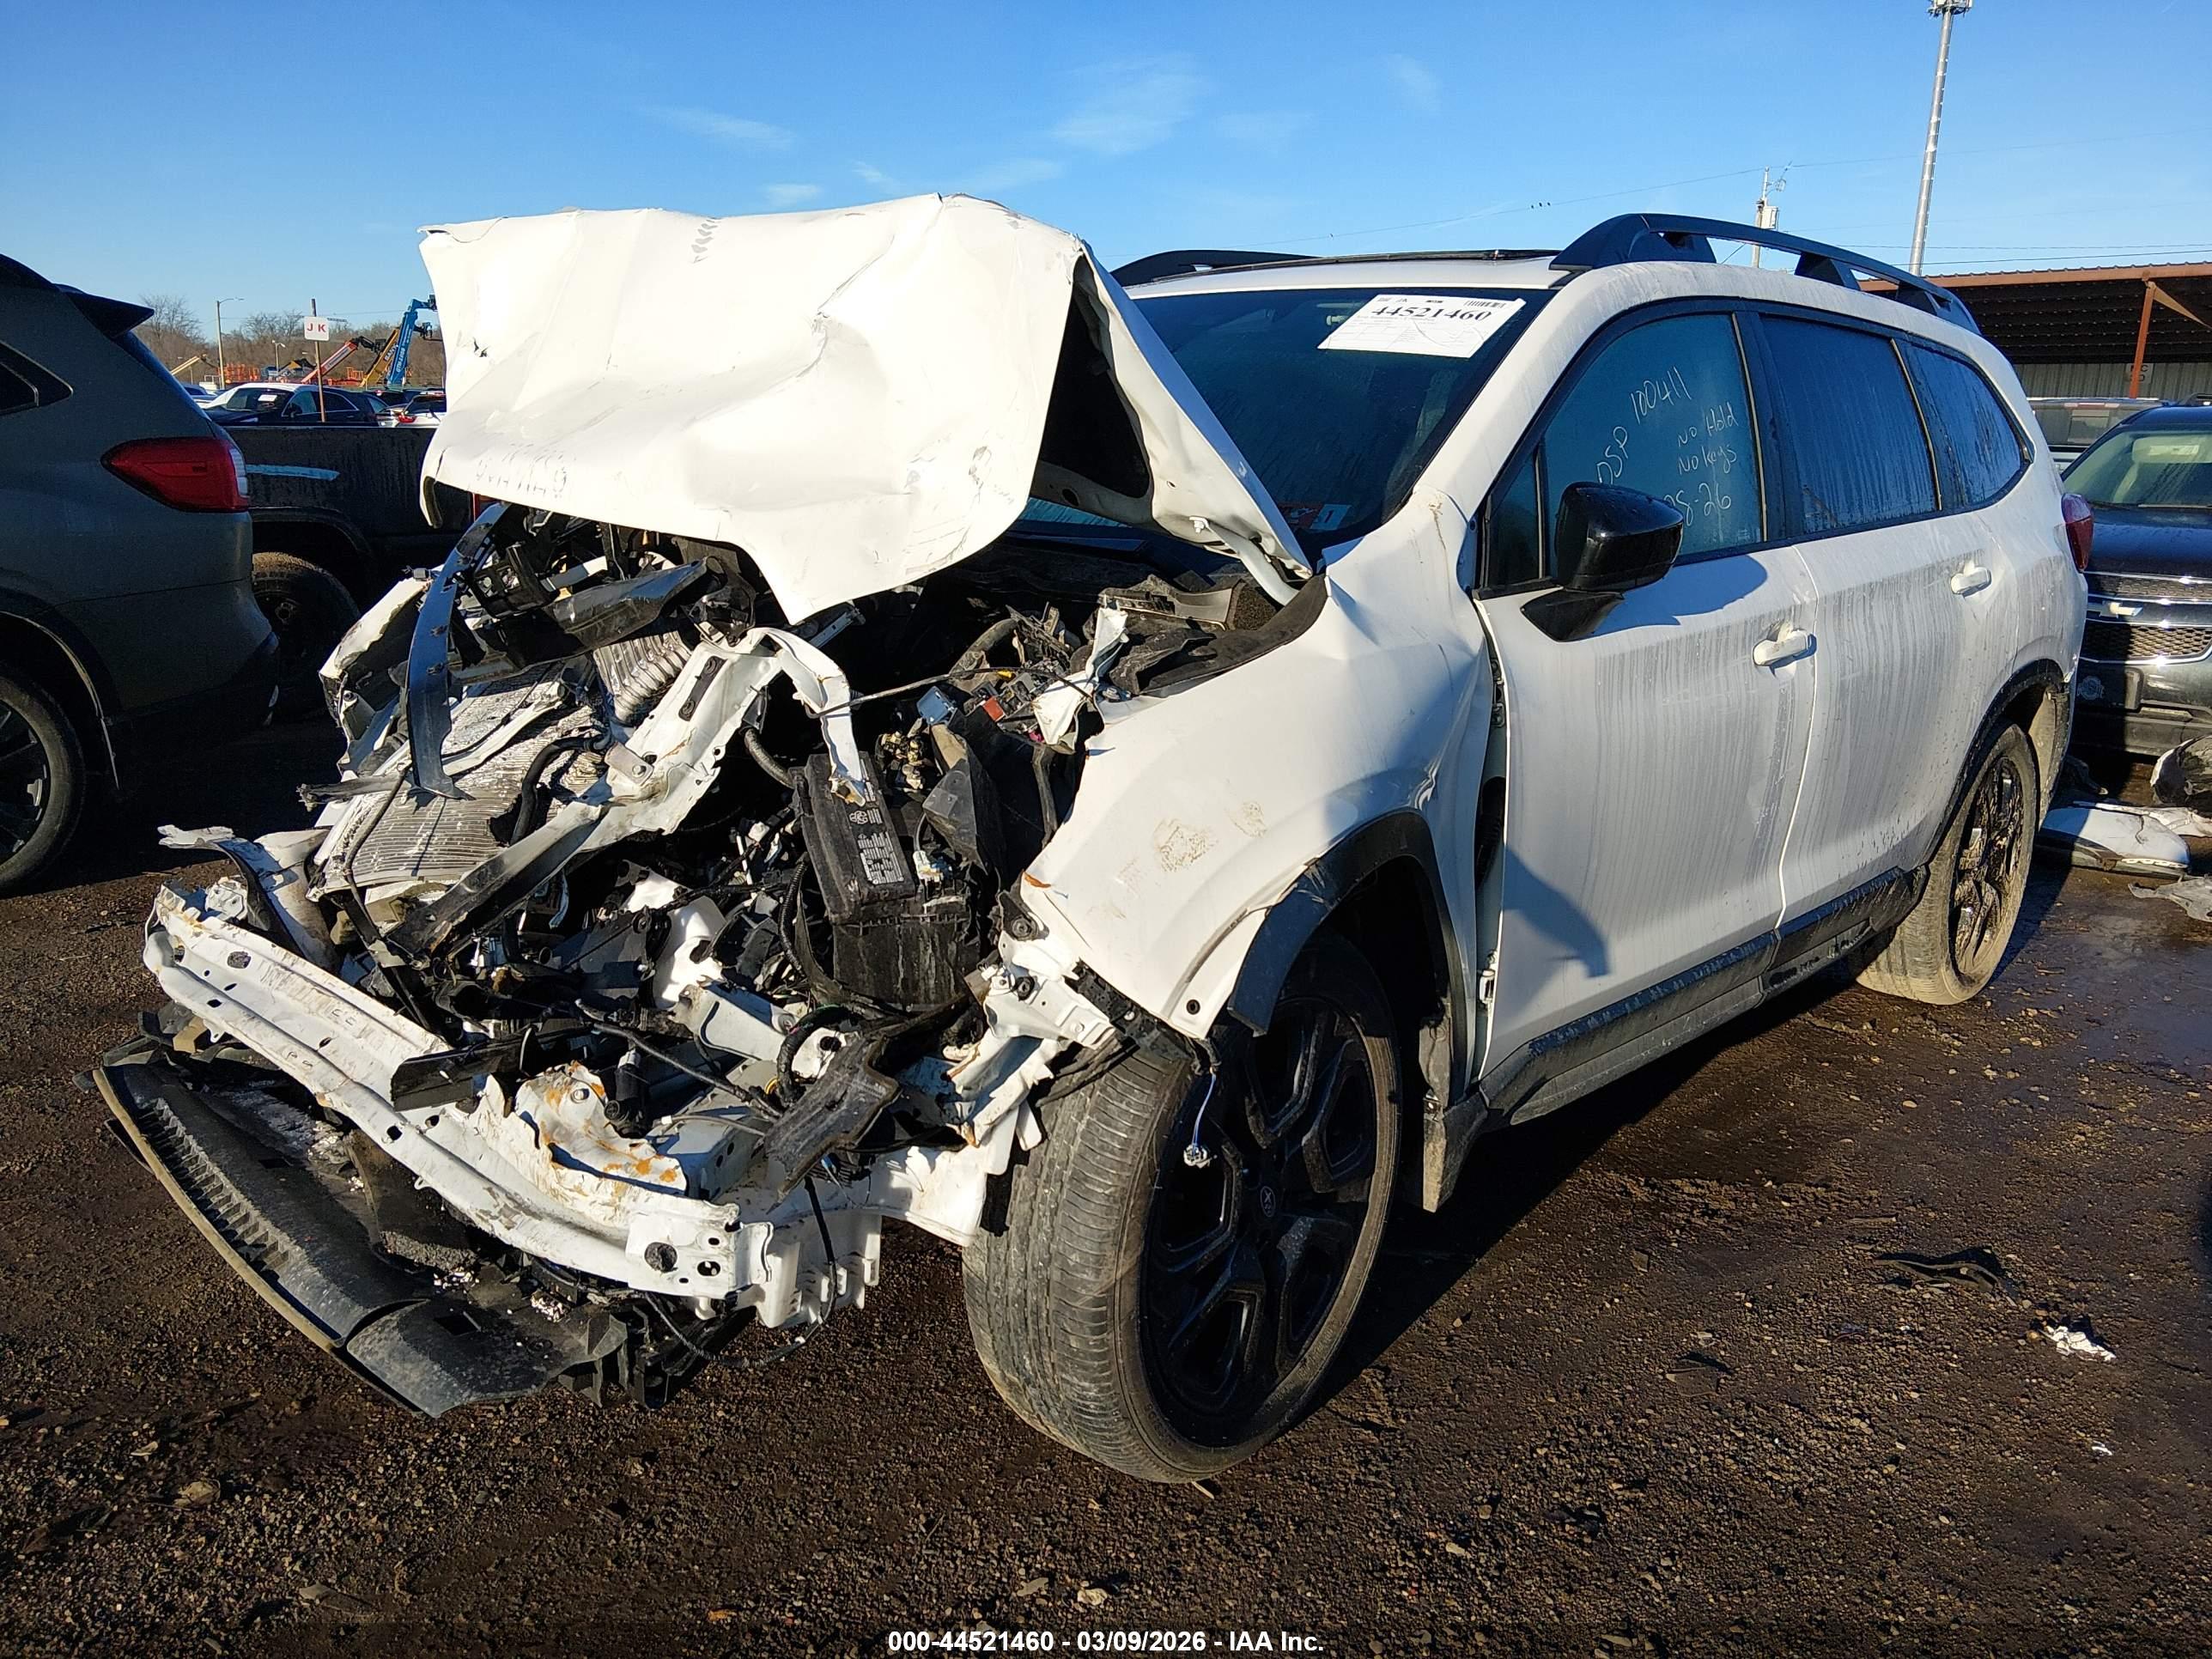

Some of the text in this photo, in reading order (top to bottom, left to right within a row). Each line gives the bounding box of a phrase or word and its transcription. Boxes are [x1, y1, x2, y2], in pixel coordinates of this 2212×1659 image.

[1371, 304, 1492, 322] 44521460
[307, 322, 326, 333] J K
